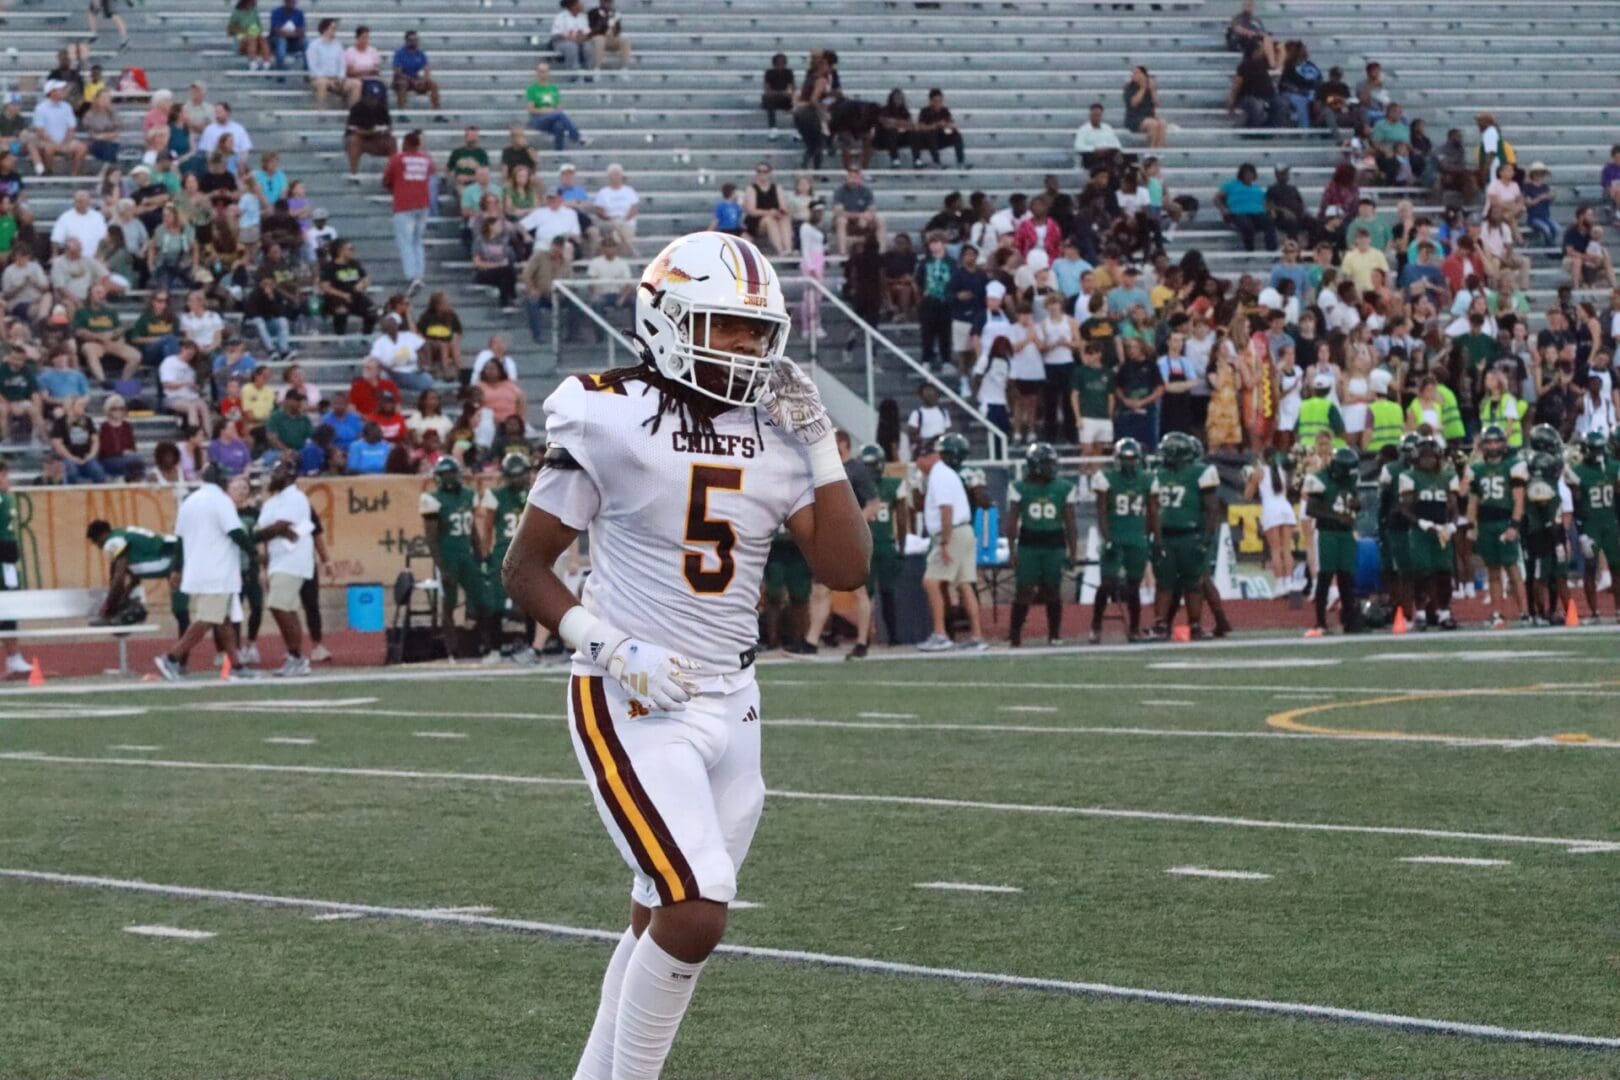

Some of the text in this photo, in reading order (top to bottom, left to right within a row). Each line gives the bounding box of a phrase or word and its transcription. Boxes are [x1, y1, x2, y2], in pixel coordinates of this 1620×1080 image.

[743, 294, 768, 308] CHIEFS
[672, 431, 755, 459] CHIEFS
[348, 487, 390, 514] but
[1480, 476, 1505, 500] 35
[1588, 484, 1614, 508] 20
[448, 511, 473, 537] 30
[681, 462, 745, 596] 5
